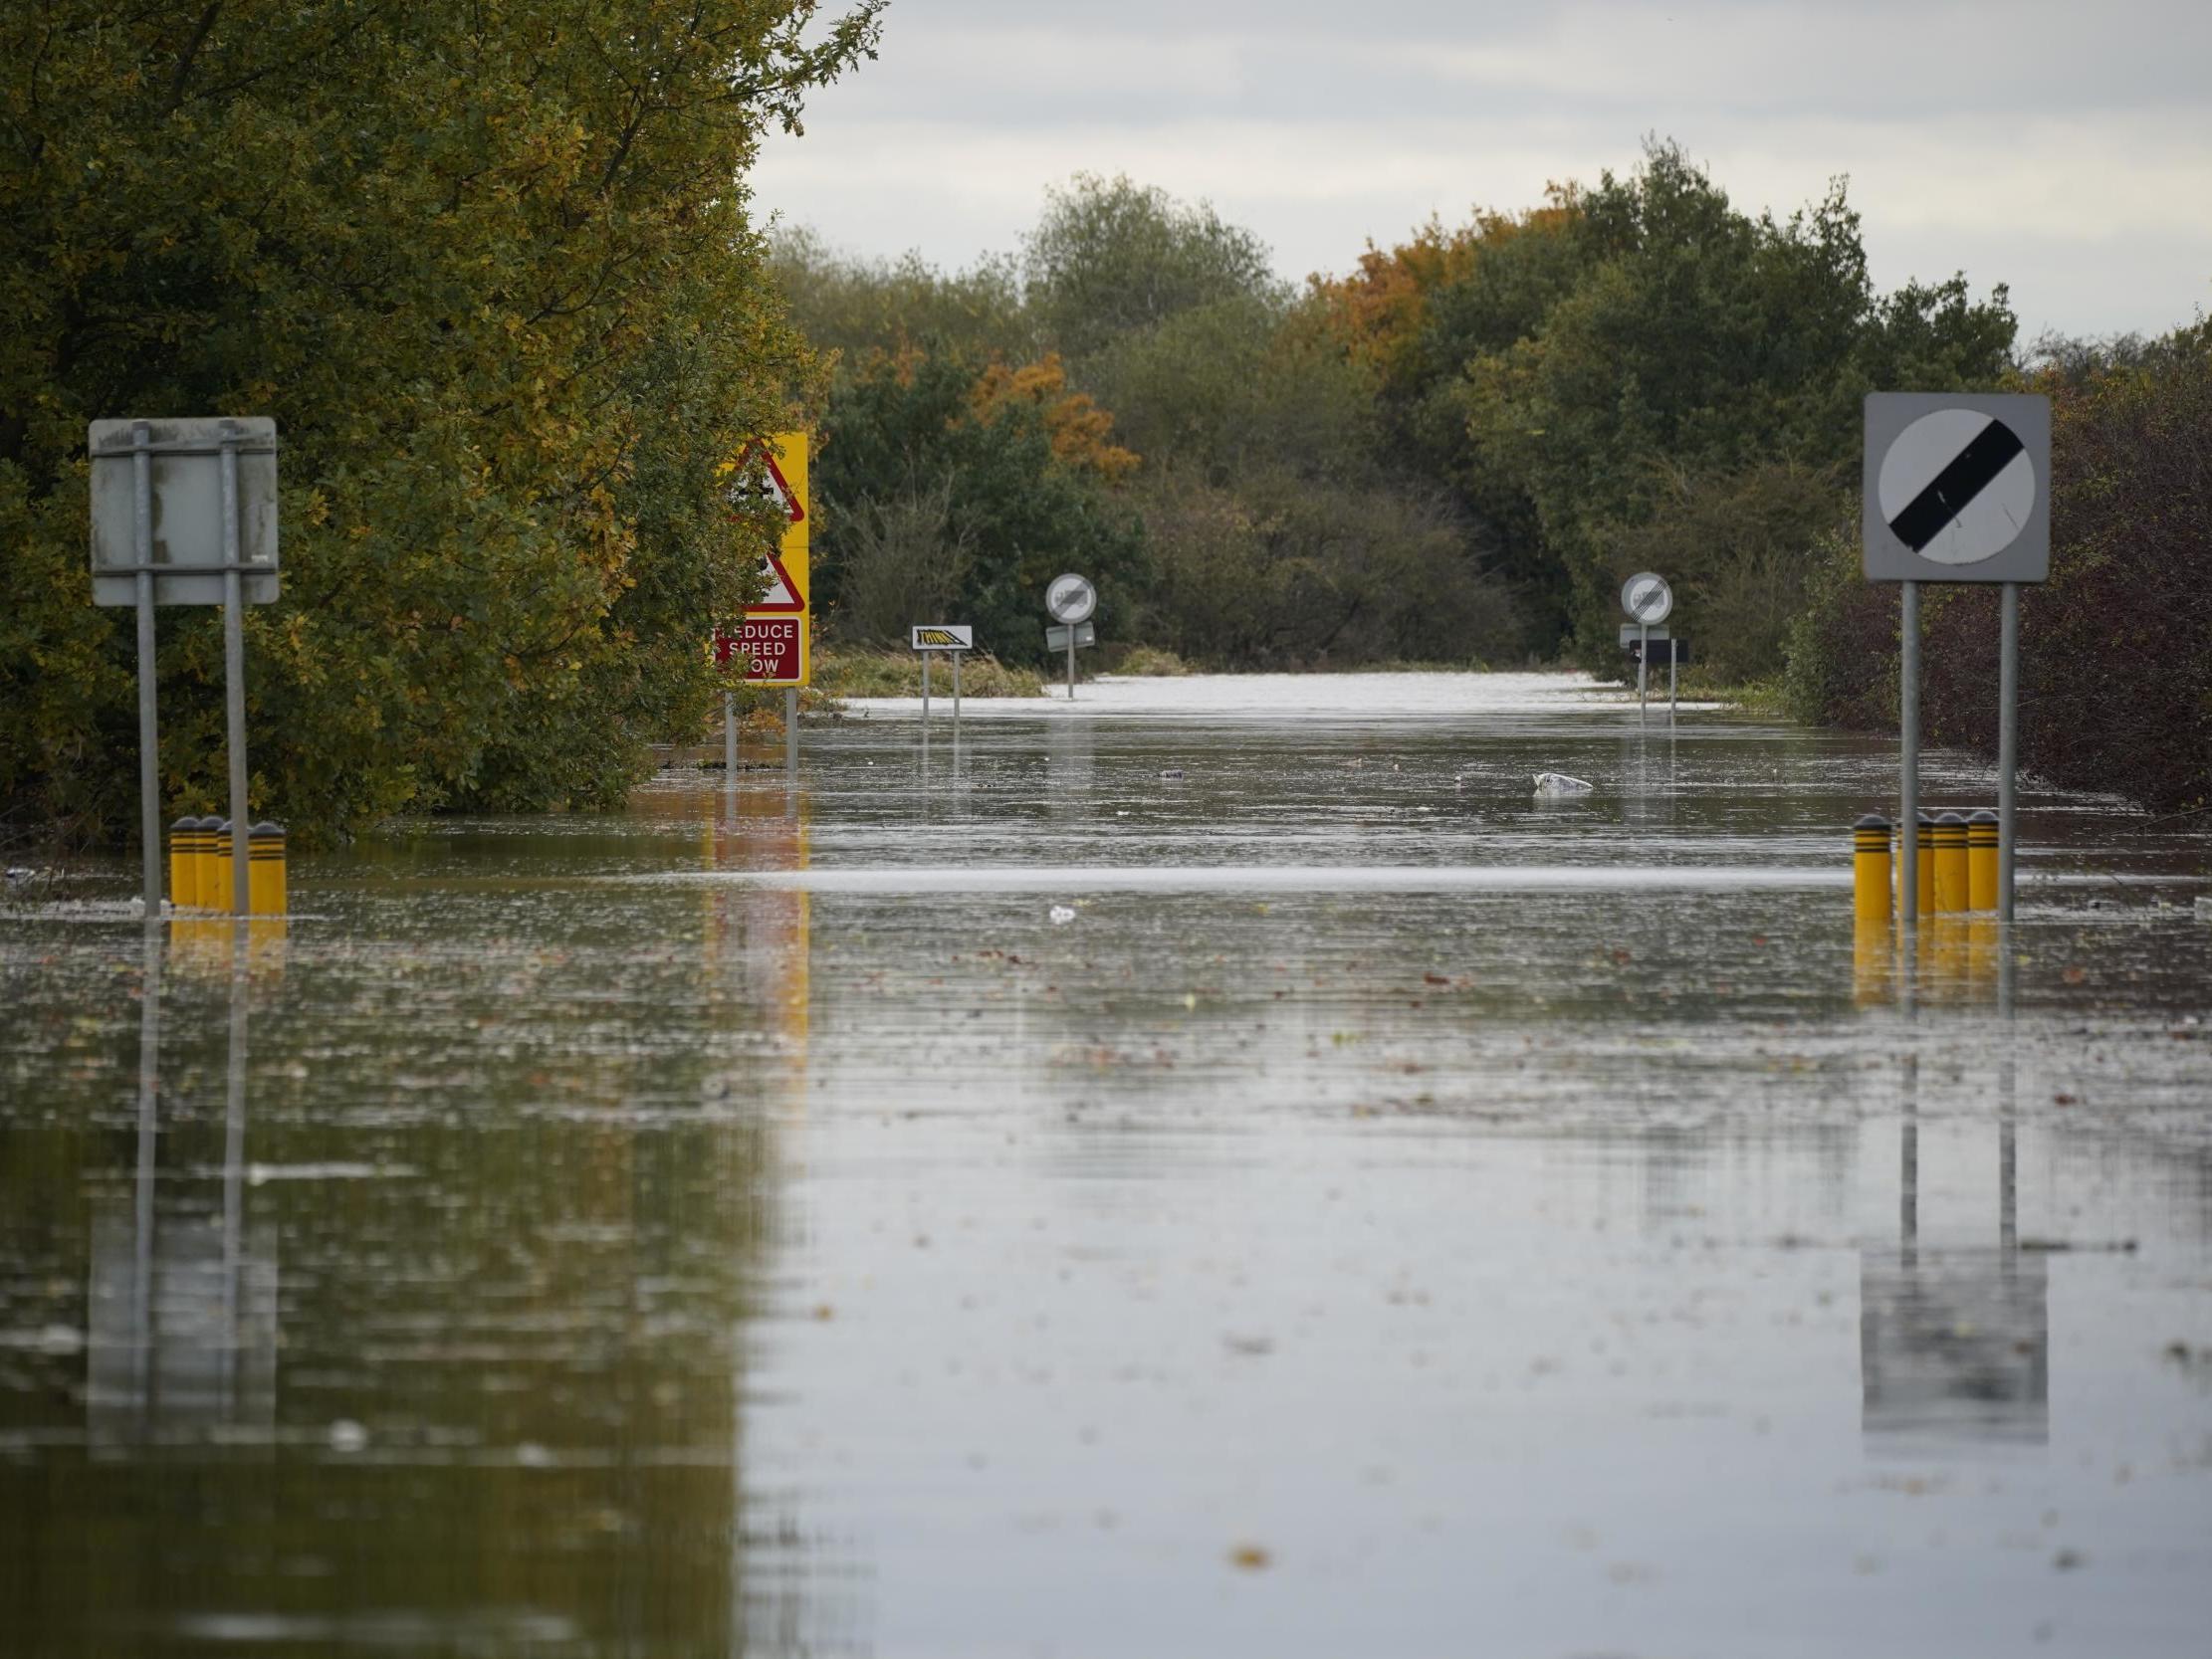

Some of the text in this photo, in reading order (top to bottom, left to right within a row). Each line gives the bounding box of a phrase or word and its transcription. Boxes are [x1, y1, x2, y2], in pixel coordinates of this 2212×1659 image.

[723, 624, 793, 638] EDUCE
[729, 642, 785, 656] SPEED
[749, 658, 778, 673] OW
